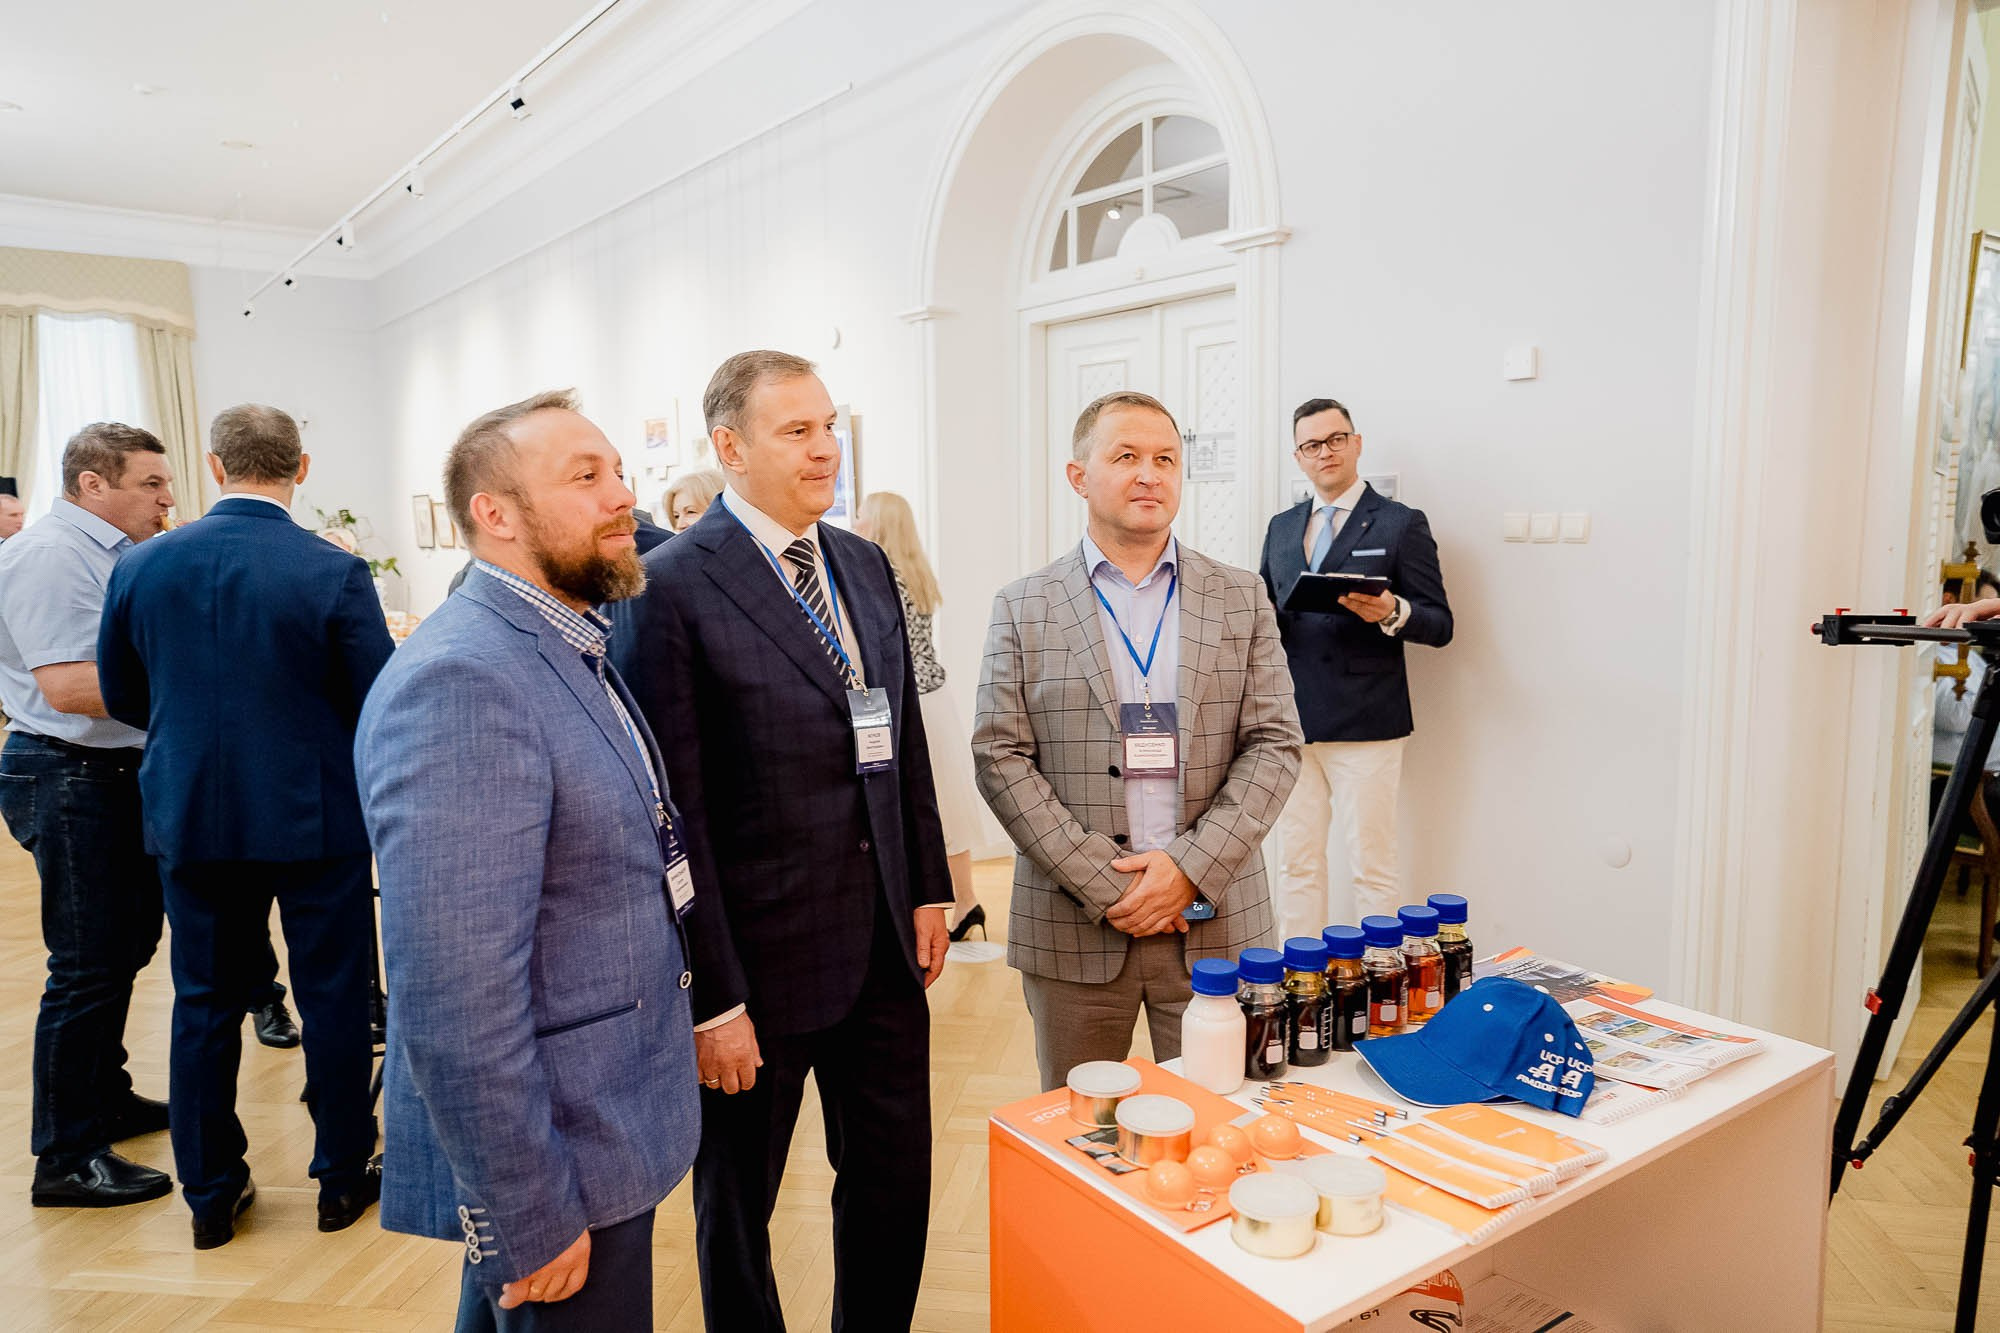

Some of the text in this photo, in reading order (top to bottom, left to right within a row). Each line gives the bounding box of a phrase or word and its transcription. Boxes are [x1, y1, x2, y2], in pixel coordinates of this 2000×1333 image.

[1540, 1049, 1565, 1066] UCP
[1567, 1057, 1593, 1073] UCP
[1359, 1308, 1380, 1321] 61
